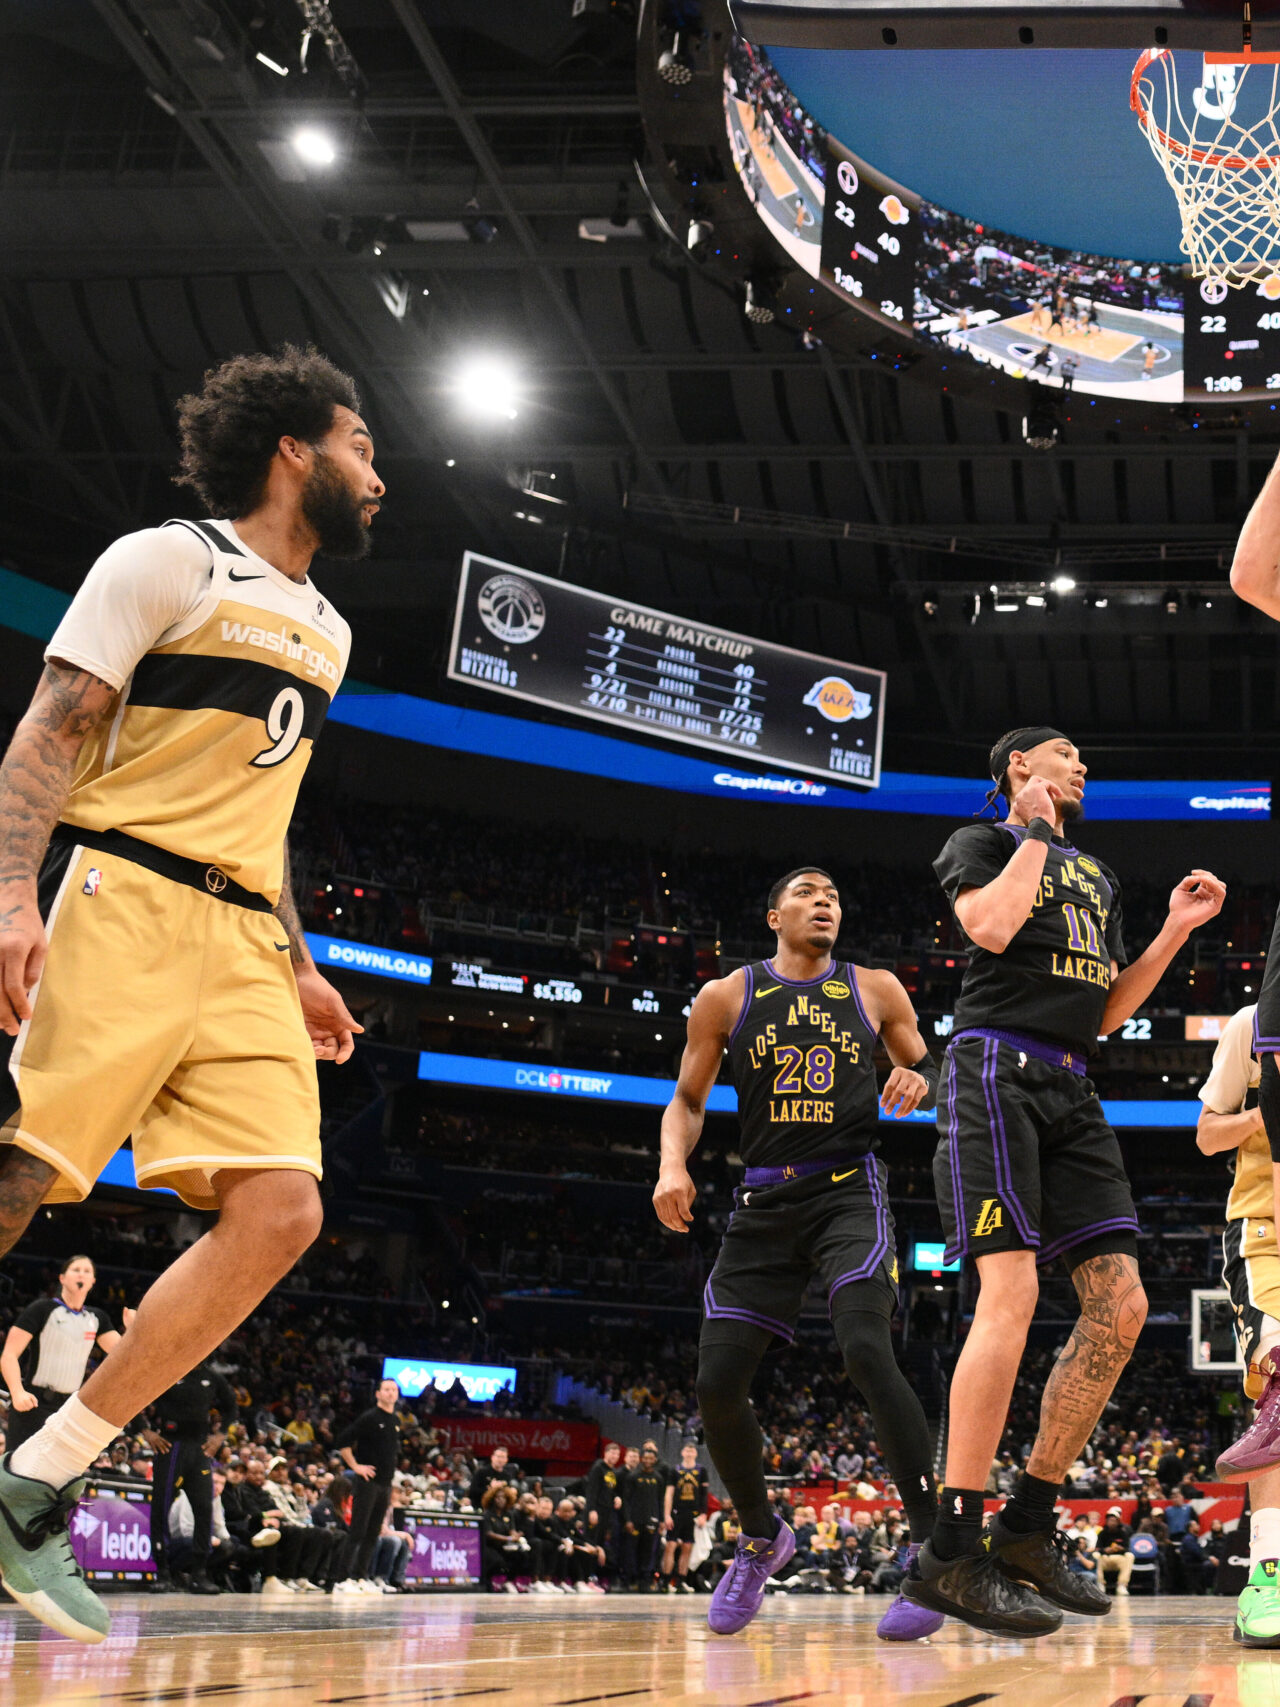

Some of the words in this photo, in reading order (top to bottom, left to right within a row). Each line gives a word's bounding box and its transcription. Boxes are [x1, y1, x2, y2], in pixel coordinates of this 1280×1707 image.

[834, 200, 855, 229] 22
[877, 232, 900, 256] 40
[834, 267, 863, 298] 1:06
[1200, 316, 1227, 333] 22
[1203, 376, 1243, 392] 1:06
[220, 620, 340, 683] washington
[610, 607, 662, 636] GAME
[665, 623, 754, 659] MATCHUP
[461, 656, 518, 687] WIZARDS
[604, 626, 626, 643] 22
[733, 663, 755, 679] 40
[607, 645, 620, 658] 7
[734, 680, 752, 695] 12
[591, 674, 627, 695] 9/21
[718, 709, 762, 731] 17/25
[605, 661, 617, 675] 4
[733, 696, 751, 711] 12
[248, 686, 305, 769] 9
[587, 691, 627, 712] 4/10
[720, 725, 757, 746] 5/10
[829, 756, 871, 778] LAKERS
[1062, 902, 1101, 957] 11
[328, 943, 432, 979] DOWNLOAD
[1052, 953, 1110, 991] LAKERS
[533, 982, 583, 1004] $5,550
[632, 998, 659, 1013] 9/21
[749, 1024, 778, 1069] LOS
[787, 995, 861, 1065] ANGELES
[1121, 1018, 1152, 1040] 22
[773, 1045, 835, 1095] 28
[769, 1101, 835, 1124] LAKERS
[970, 1199, 1004, 1237] LA
[101, 1520, 152, 1561] leido
[431, 1540, 468, 1571] leidos
